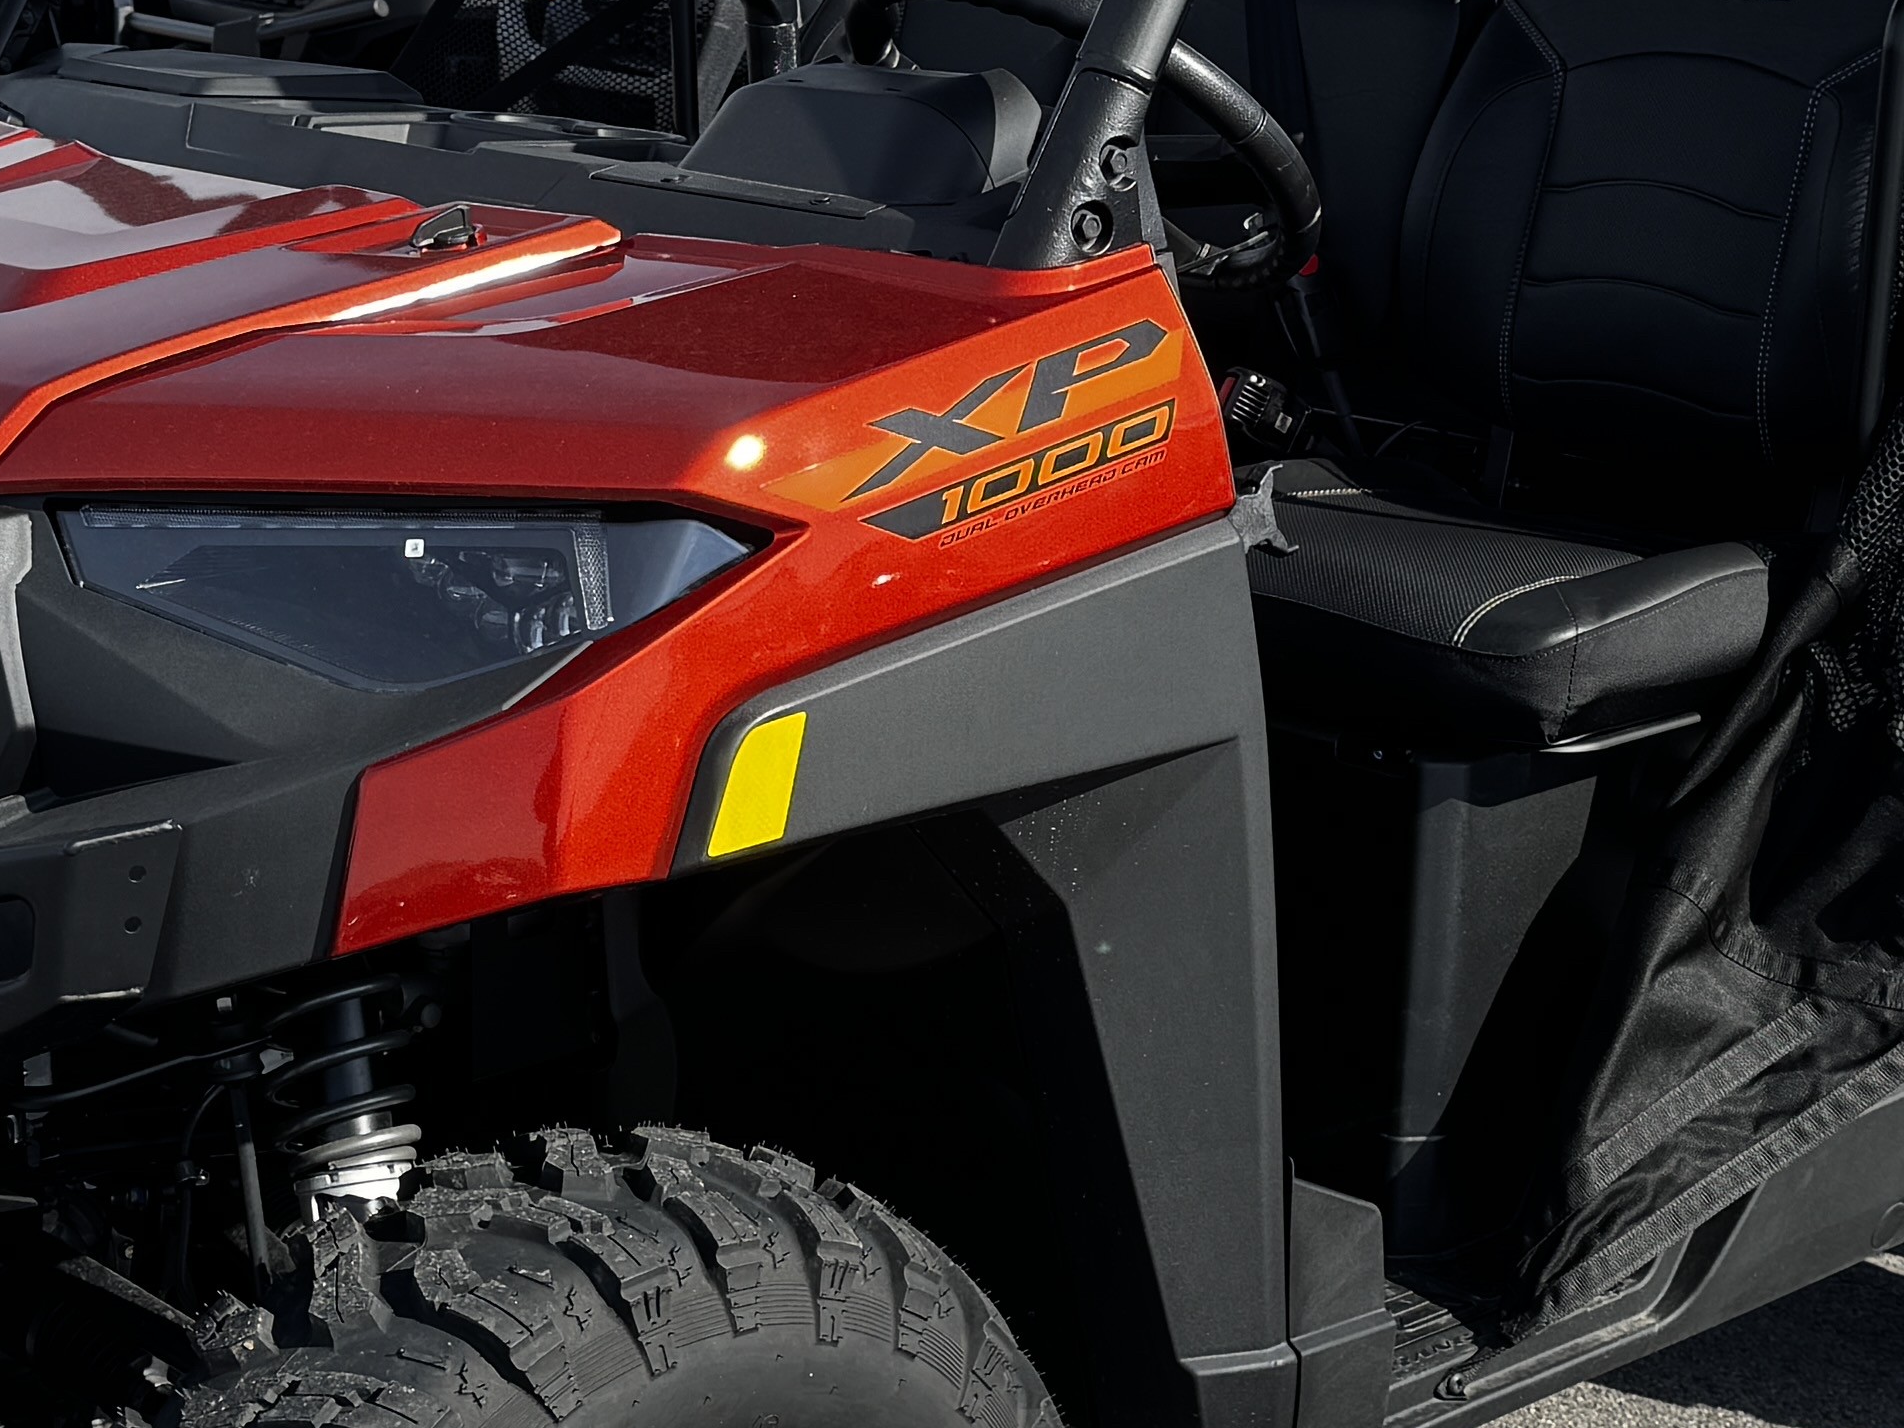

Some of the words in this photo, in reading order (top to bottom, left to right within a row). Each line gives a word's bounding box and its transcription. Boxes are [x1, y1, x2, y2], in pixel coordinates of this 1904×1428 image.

[840, 318, 1168, 502] XP
[941, 405, 1171, 525] 1000
[940, 518, 997, 548] DUAL
[1005, 469, 1117, 521] OVERHEAD
[1121, 448, 1166, 475] CAM
